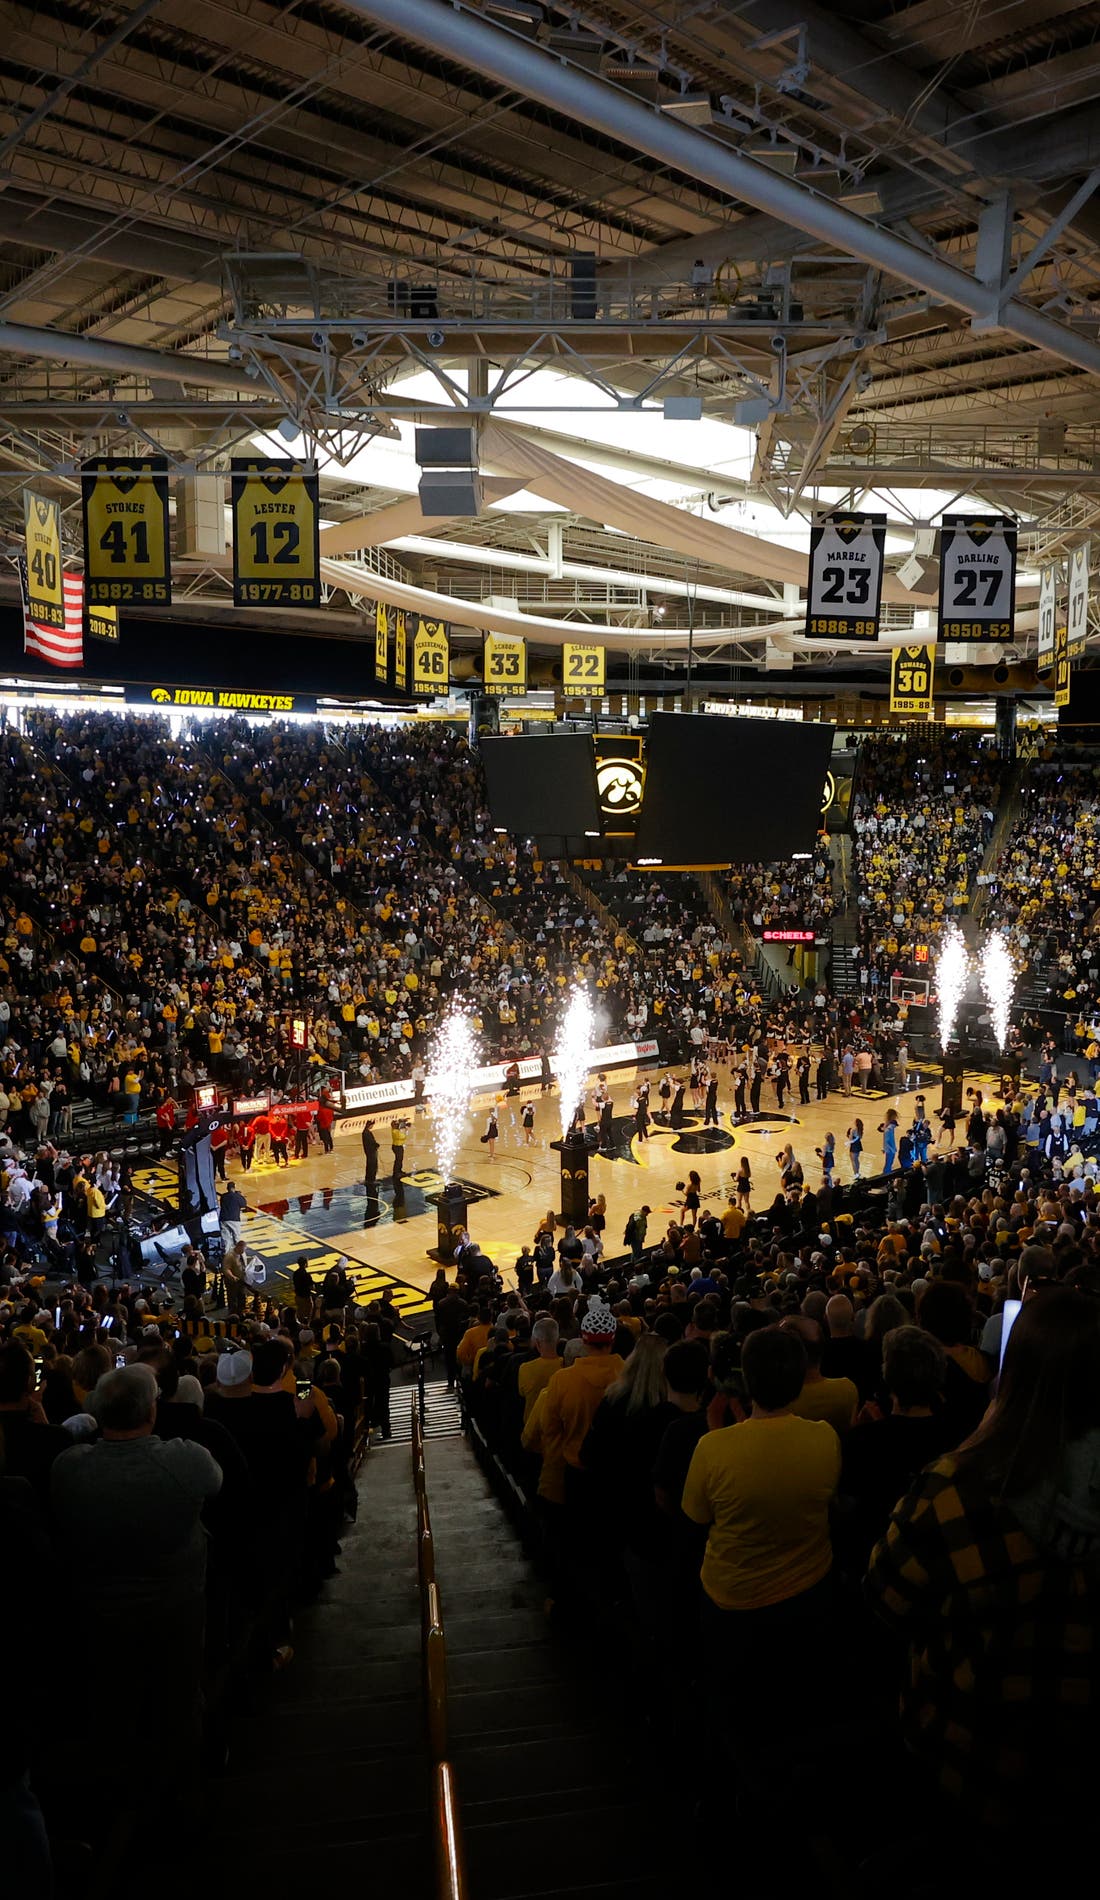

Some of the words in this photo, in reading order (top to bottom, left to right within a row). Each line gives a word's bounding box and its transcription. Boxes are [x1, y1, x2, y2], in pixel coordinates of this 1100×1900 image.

[105, 502, 145, 514] STOKES
[254, 503, 296, 516] LESTER
[100, 521, 150, 563] 41
[250, 522, 300, 564] 12
[827, 551, 867, 563] MARBLE
[957, 554, 1000, 565] DARLING
[31, 549, 56, 590] 40
[90, 583, 167, 599] 1982-85
[240, 583, 314, 600] 1977-80
[821, 567, 871, 604] 23
[952, 569, 1003, 607] 27
[29, 602, 63, 623] 1991-93
[1071, 592, 1085, 628] 17
[89, 619, 117, 638] 2018-21
[810, 619, 876, 635] 1986-89
[942, 623, 1010, 638] 1950-52
[1040, 608, 1052, 641] 10
[377, 630, 385, 657] 21
[418, 651, 444, 675] 46
[490, 654, 520, 675] 33
[568, 654, 599, 677] 22
[900, 661, 927, 670] EDWARDS
[897, 670, 927, 692] 30
[1057, 661, 1067, 685] 10
[414, 683, 449, 695] 1954-56
[484, 685, 526, 695] 1954-56
[563, 686, 605, 696] 1954-56
[174, 689, 214, 706] IOWA
[218, 692, 294, 710] HAWKEYES
[892, 701, 930, 709] 1985-88
[763, 931, 815, 940] SCHEELS
[915, 950, 927, 961] 30
[292, 1029, 305, 1045] 30
[345, 1085, 398, 1104] ontinental
